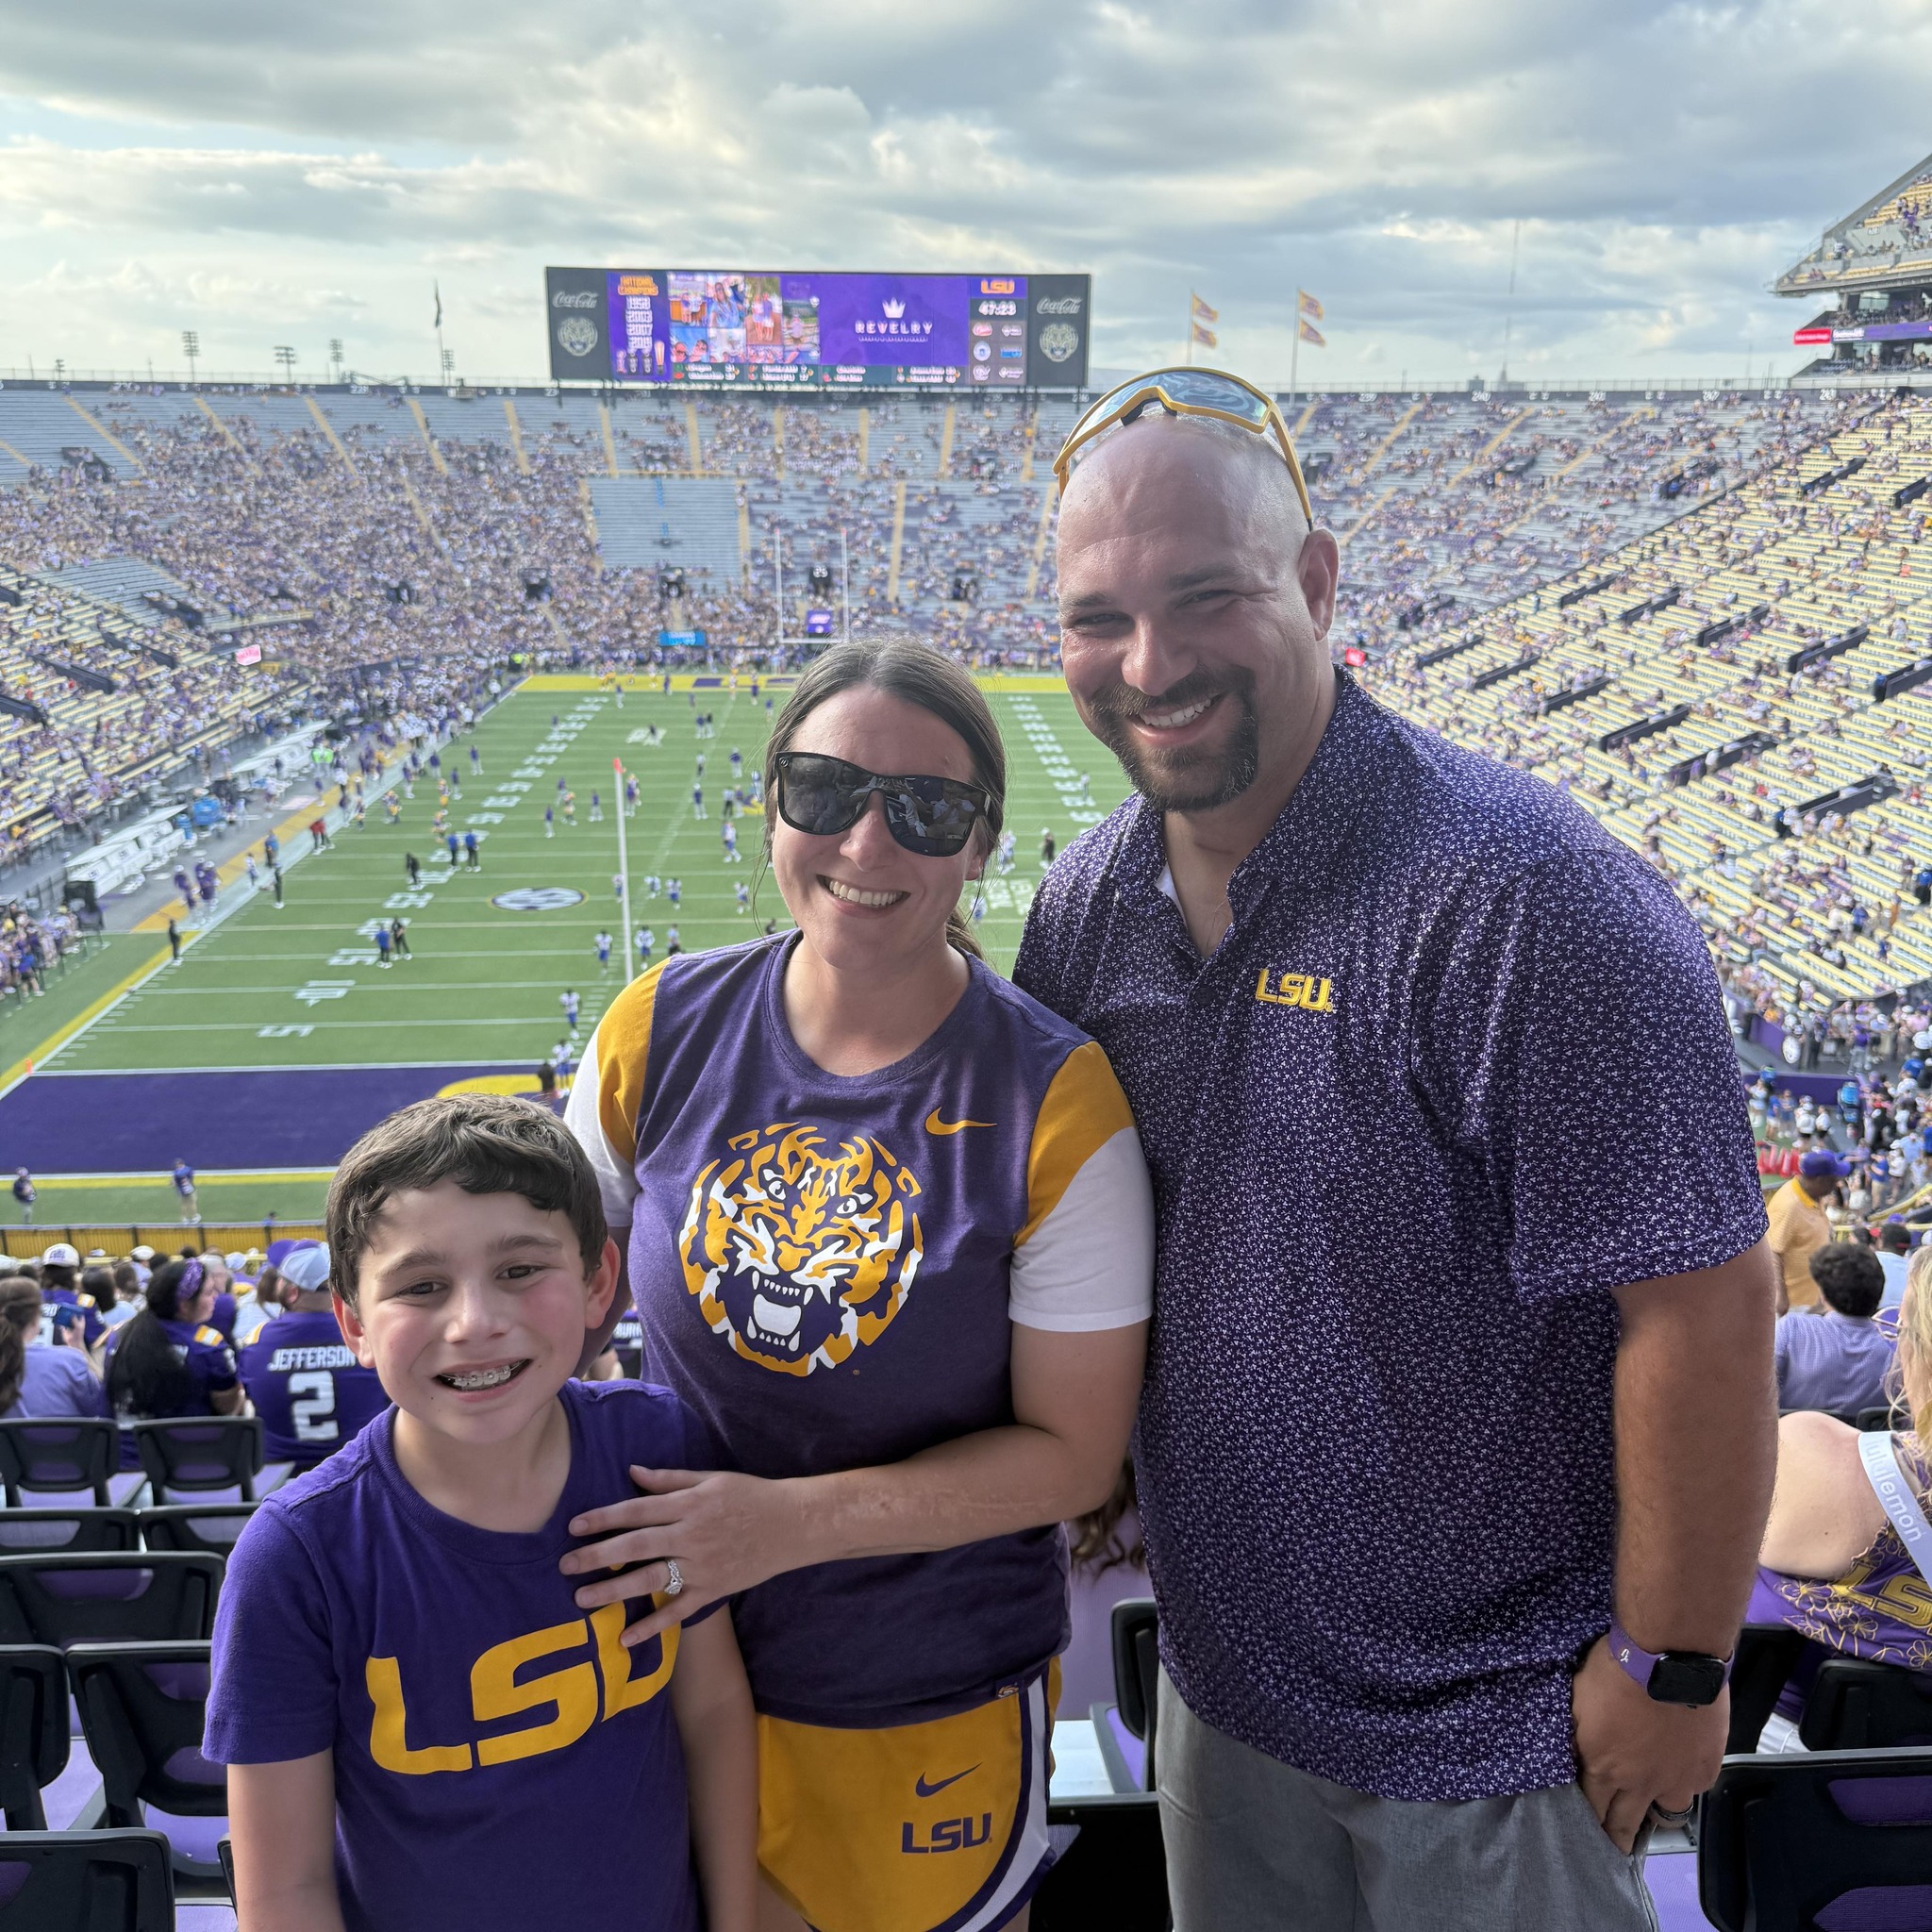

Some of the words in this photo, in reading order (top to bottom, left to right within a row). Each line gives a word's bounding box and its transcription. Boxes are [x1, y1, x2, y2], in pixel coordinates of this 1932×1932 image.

[978, 301, 1017, 315] 47:23
[981, 280, 1014, 294] LSU
[855, 321, 933, 335] REVELRY
[1256, 968, 1332, 1011] LSU
[257, 1024, 316, 1038] 5
[267, 1344, 356, 1372] JEFFERSON
[288, 1370, 340, 1441] 2
[1865, 1437, 1923, 1543] lululemon
[1832, 1561, 1932, 1634] LS
[365, 1585, 682, 1775] LSU
[902, 1811, 992, 1854] LSU
